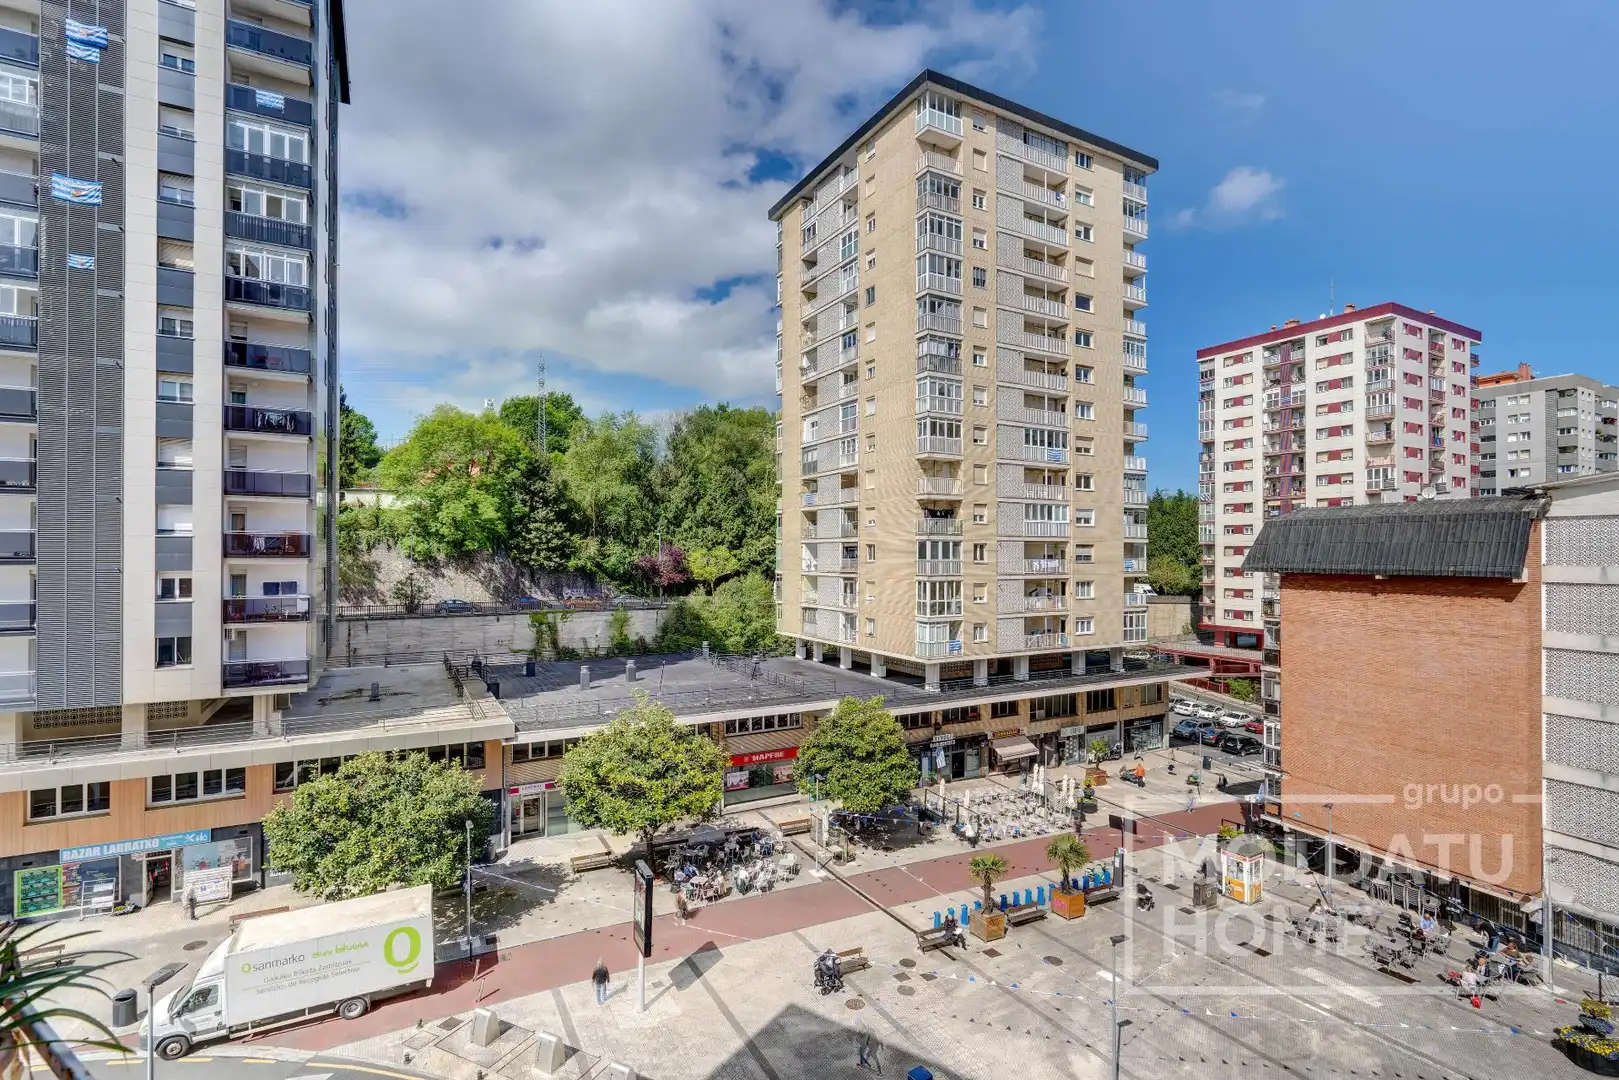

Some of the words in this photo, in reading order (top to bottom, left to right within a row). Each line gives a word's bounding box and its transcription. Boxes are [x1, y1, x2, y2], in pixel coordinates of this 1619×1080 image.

[751, 750, 785, 761] MAPFRE
[63, 846, 101, 860] BAZAR
[103, 838, 159, 855] LARRATKO
[298, 974, 330, 987] Recogida
